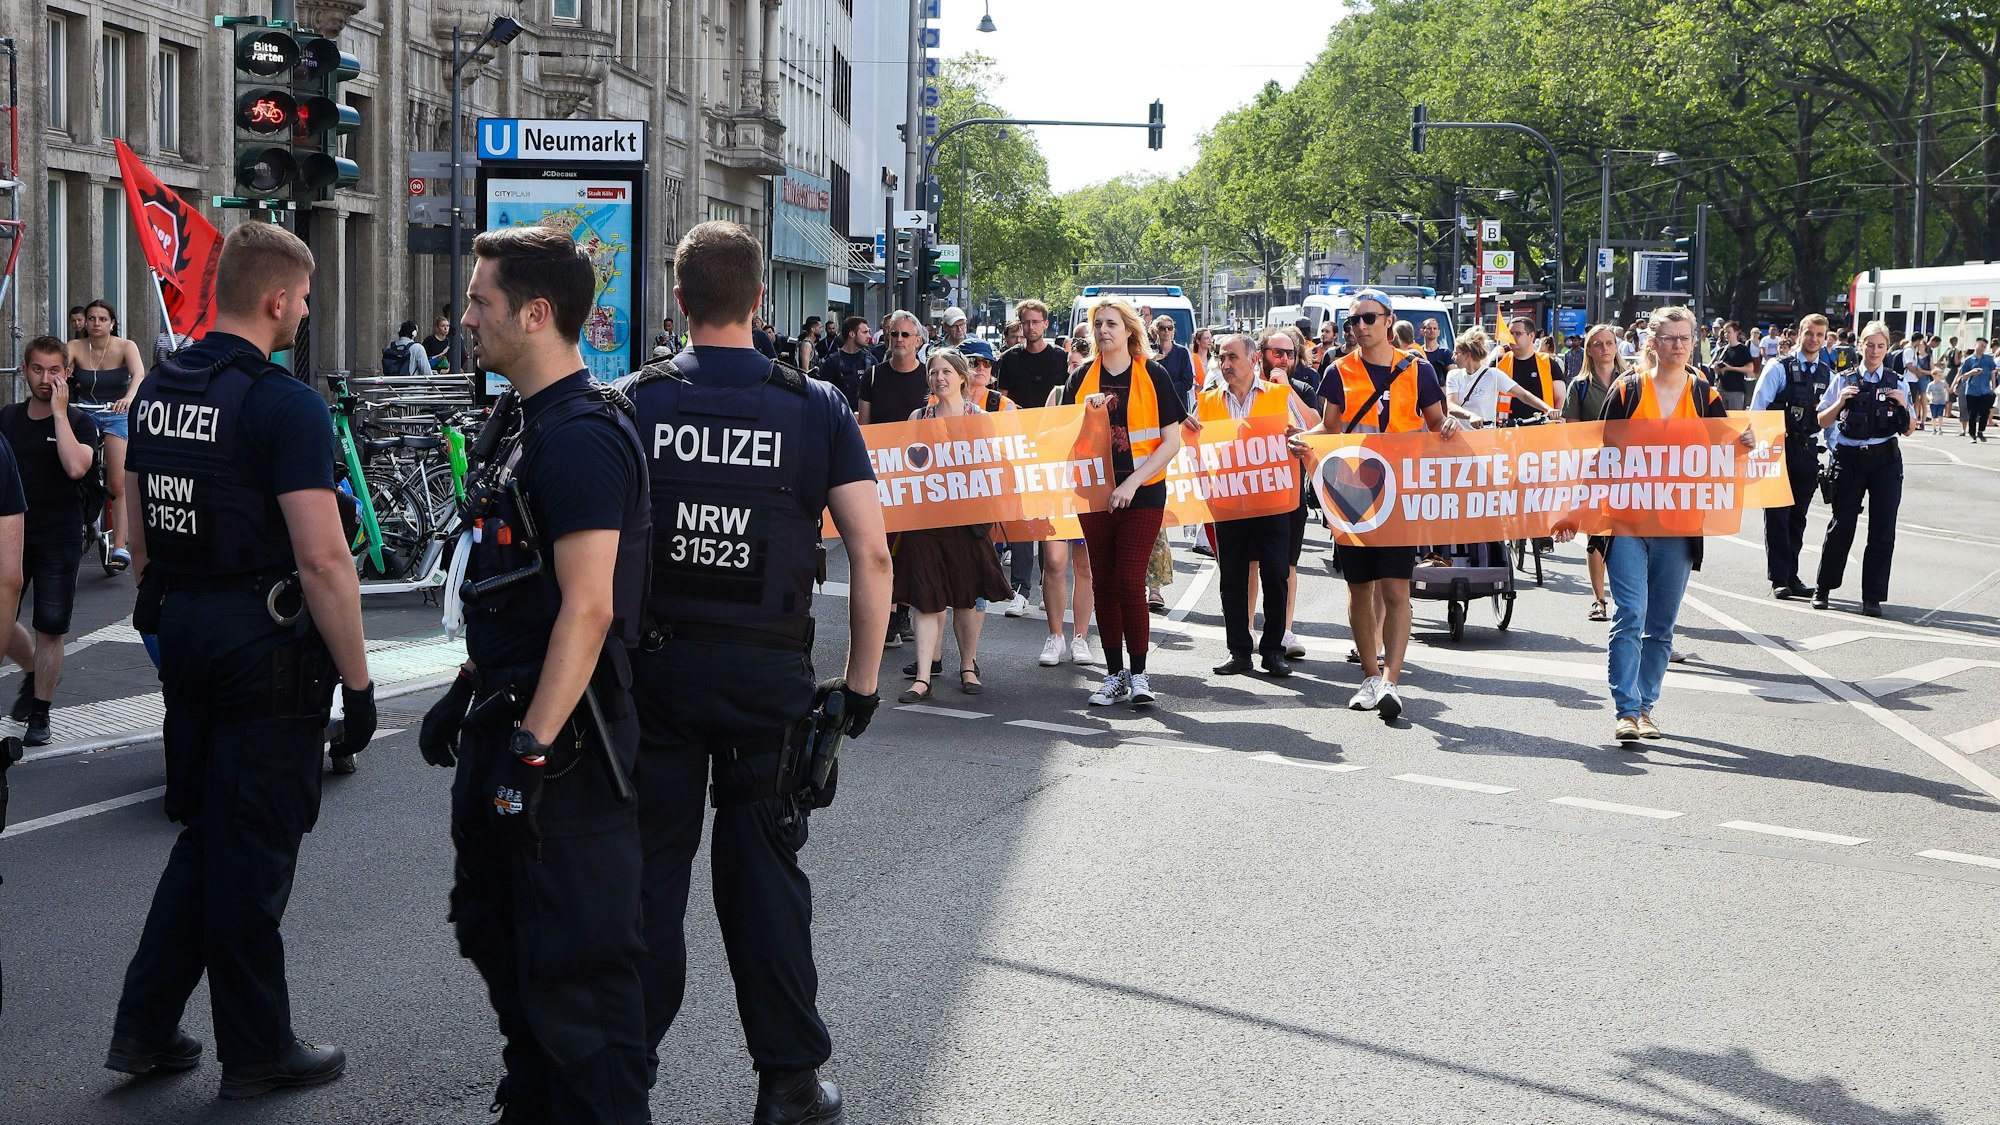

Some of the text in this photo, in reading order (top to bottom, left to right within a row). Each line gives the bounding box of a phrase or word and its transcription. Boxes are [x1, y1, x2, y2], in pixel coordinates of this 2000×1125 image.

[253, 42, 278, 52] Bitte
[485, 124, 637, 156] U Neumarkt
[541, 170, 578, 178] JCDecaux
[494, 190, 531, 198] CITYPLAN
[848, 243, 874, 252] COPY
[1488, 228, 1497, 239] B
[940, 249, 955, 257] EERS
[1496, 257, 1504, 266] H
[137, 400, 220, 442] POLIZEI
[341, 438, 351, 455] Bolt
[653, 423, 782, 468] POLIZEI
[867, 434, 1038, 474] EMOKRATIE:
[1166, 434, 1289, 476] ERATION
[876, 457, 1106, 507] AFTSRAT JETZT!
[1402, 444, 1735, 489] LETZTE GENERATION
[1746, 459, 1782, 478] ÜTZEN
[148, 473, 194, 503] NRW
[1165, 465, 1294, 505] PPUNKTEN
[1401, 482, 1735, 521] VOR DEN KIPPPUNKTEN
[148, 503, 197, 535] 31521
[676, 502, 751, 536] NRW
[670, 535, 751, 569] 31523
